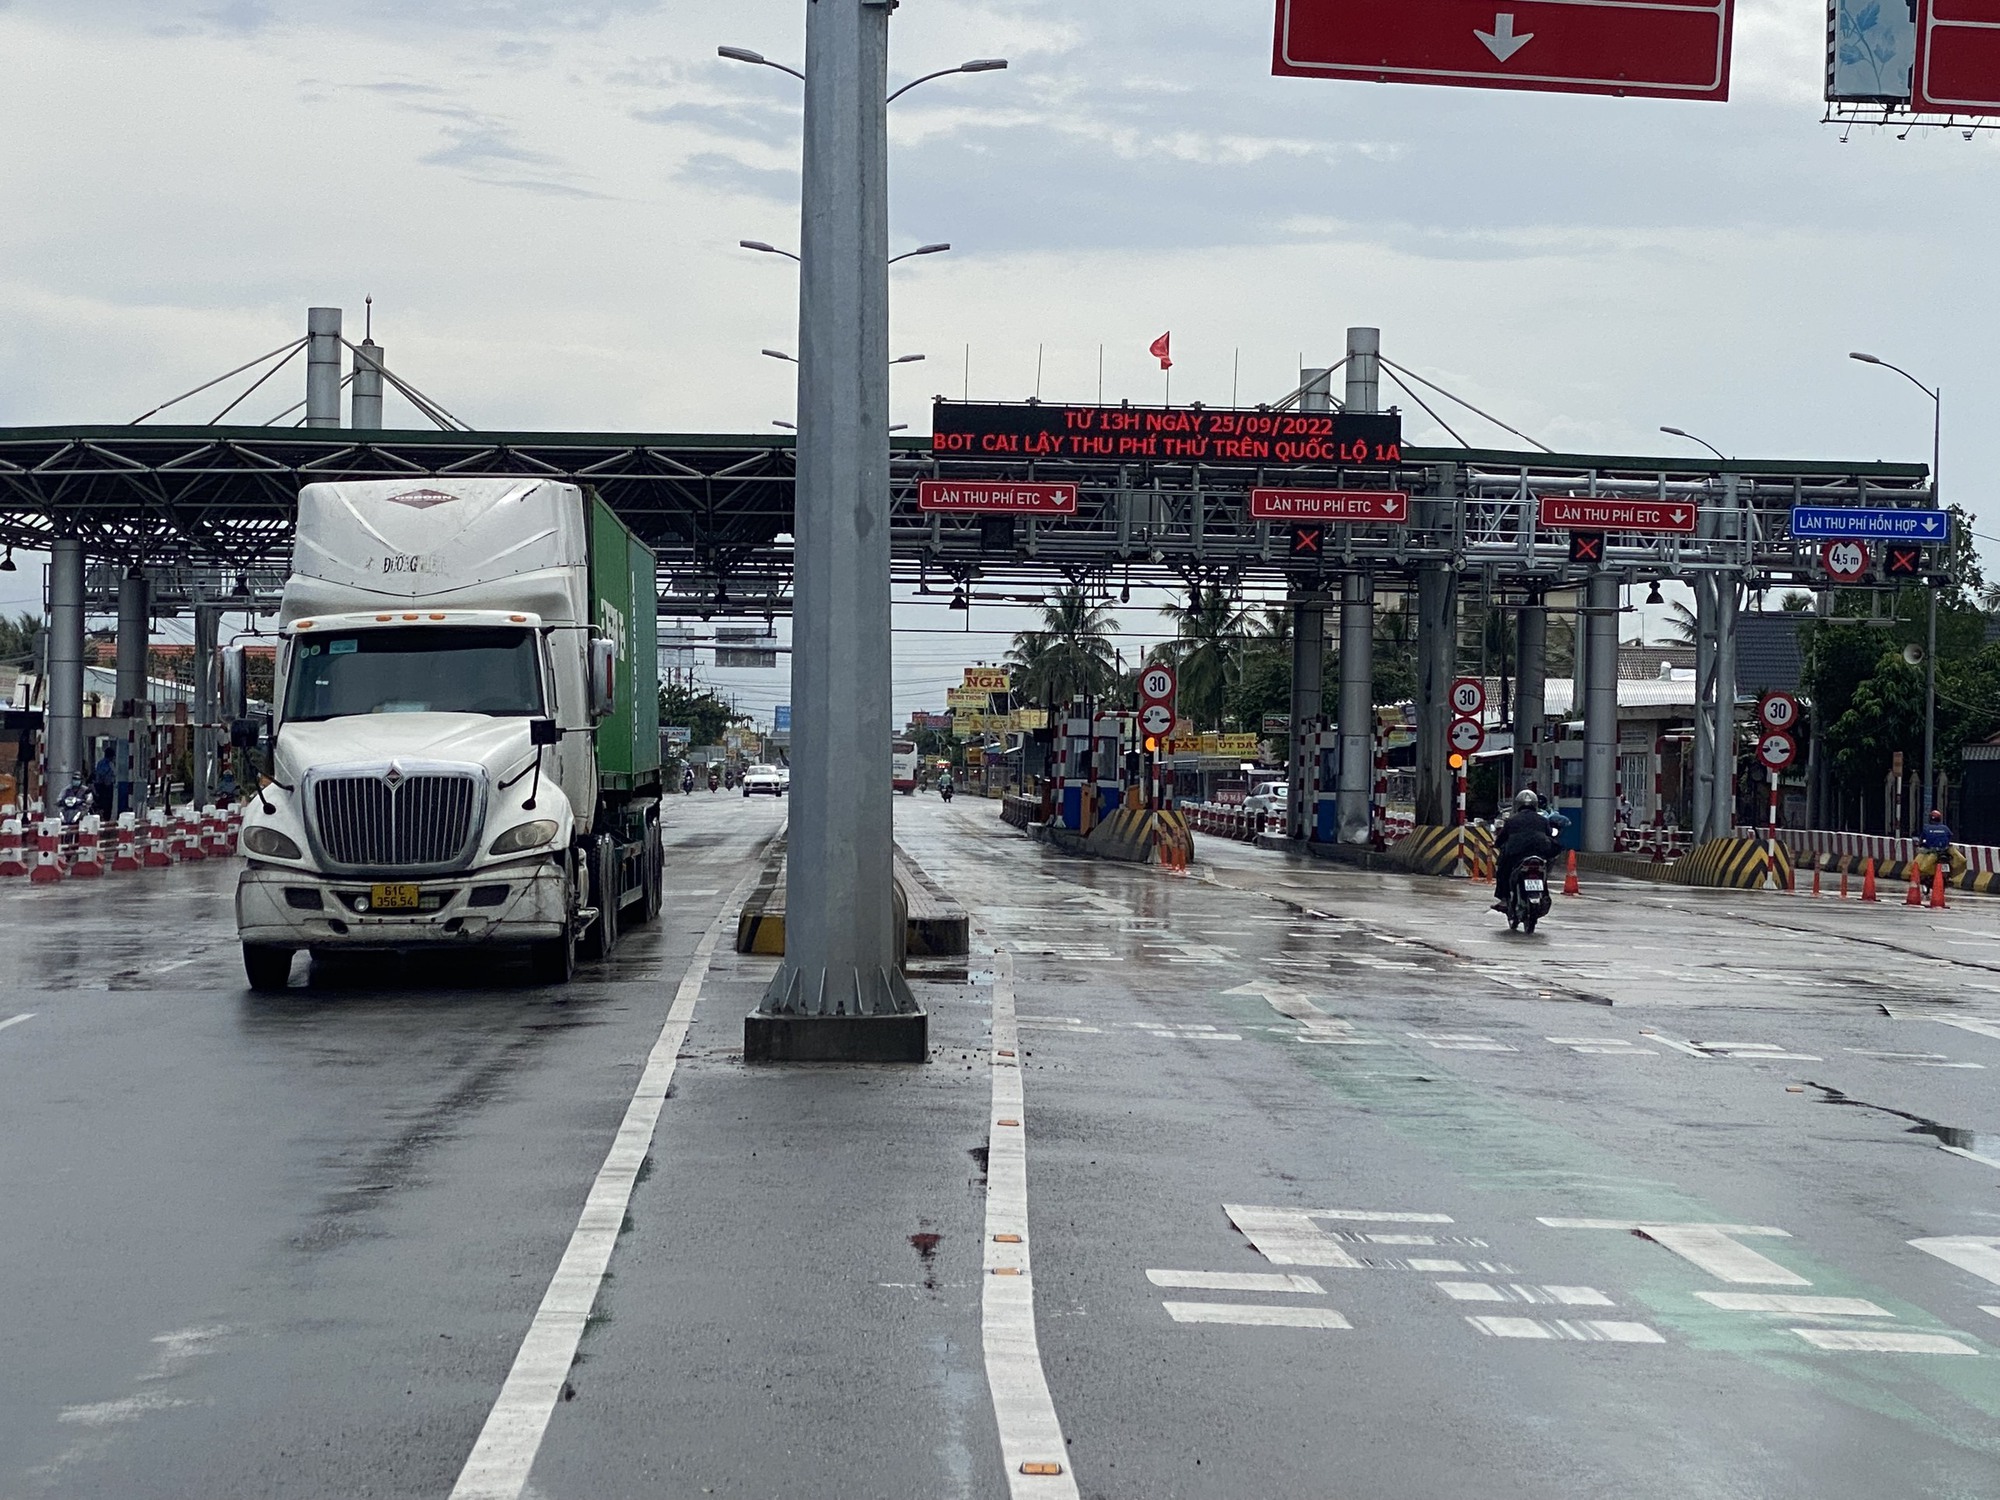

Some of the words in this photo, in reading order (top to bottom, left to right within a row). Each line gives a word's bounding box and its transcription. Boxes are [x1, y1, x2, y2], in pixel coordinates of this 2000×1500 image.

[1064, 408, 1095, 430] TỪ
[1100, 413, 1139, 430] 13H
[1146, 411, 1202, 432] NGÀY
[1210, 415, 1333, 437] 25/09/2022
[933, 433, 975, 450] BOT
[982, 435, 1018, 451] CAI
[1025, 430, 1065, 456] LẬY
[1069, 436, 1113, 453] THU
[1119, 433, 1157, 454] PHÍ
[1213, 436, 1268, 458] TRÊN
[1275, 437, 1334, 462] QUỐC
[1340, 439, 1367, 464] LỘ
[1375, 444, 1400, 461] 1A
[933, 487, 959, 503] LÀN
[963, 491, 988, 504] THU
[992, 489, 1014, 504] PHÍ
[1017, 493, 1040, 505] ETC
[1265, 495, 1291, 511] LÀN
[1294, 499, 1320, 512] THU
[1323, 497, 1346, 512] PHÍ
[1348, 501, 1371, 513] ETC
[1554, 504, 1580, 520] LÀN
[1584, 508, 1609, 521] THU
[1612, 507, 1634, 522] PHÍ
[1637, 510, 1660, 523] ETC
[1800, 513, 1821, 529] LÀN
[1825, 517, 1846, 530] THU
[1849, 515, 1866, 530] PHÍ
[1895, 518, 1917, 534] HỢP
[1851, 557, 1859, 565] m
[966, 677, 1006, 688] NGA
[1149, 676, 1165, 692] 30
[1460, 689, 1475, 706] 30
[1770, 703, 1786, 719] 30
[384, 885, 405, 896] 61C
